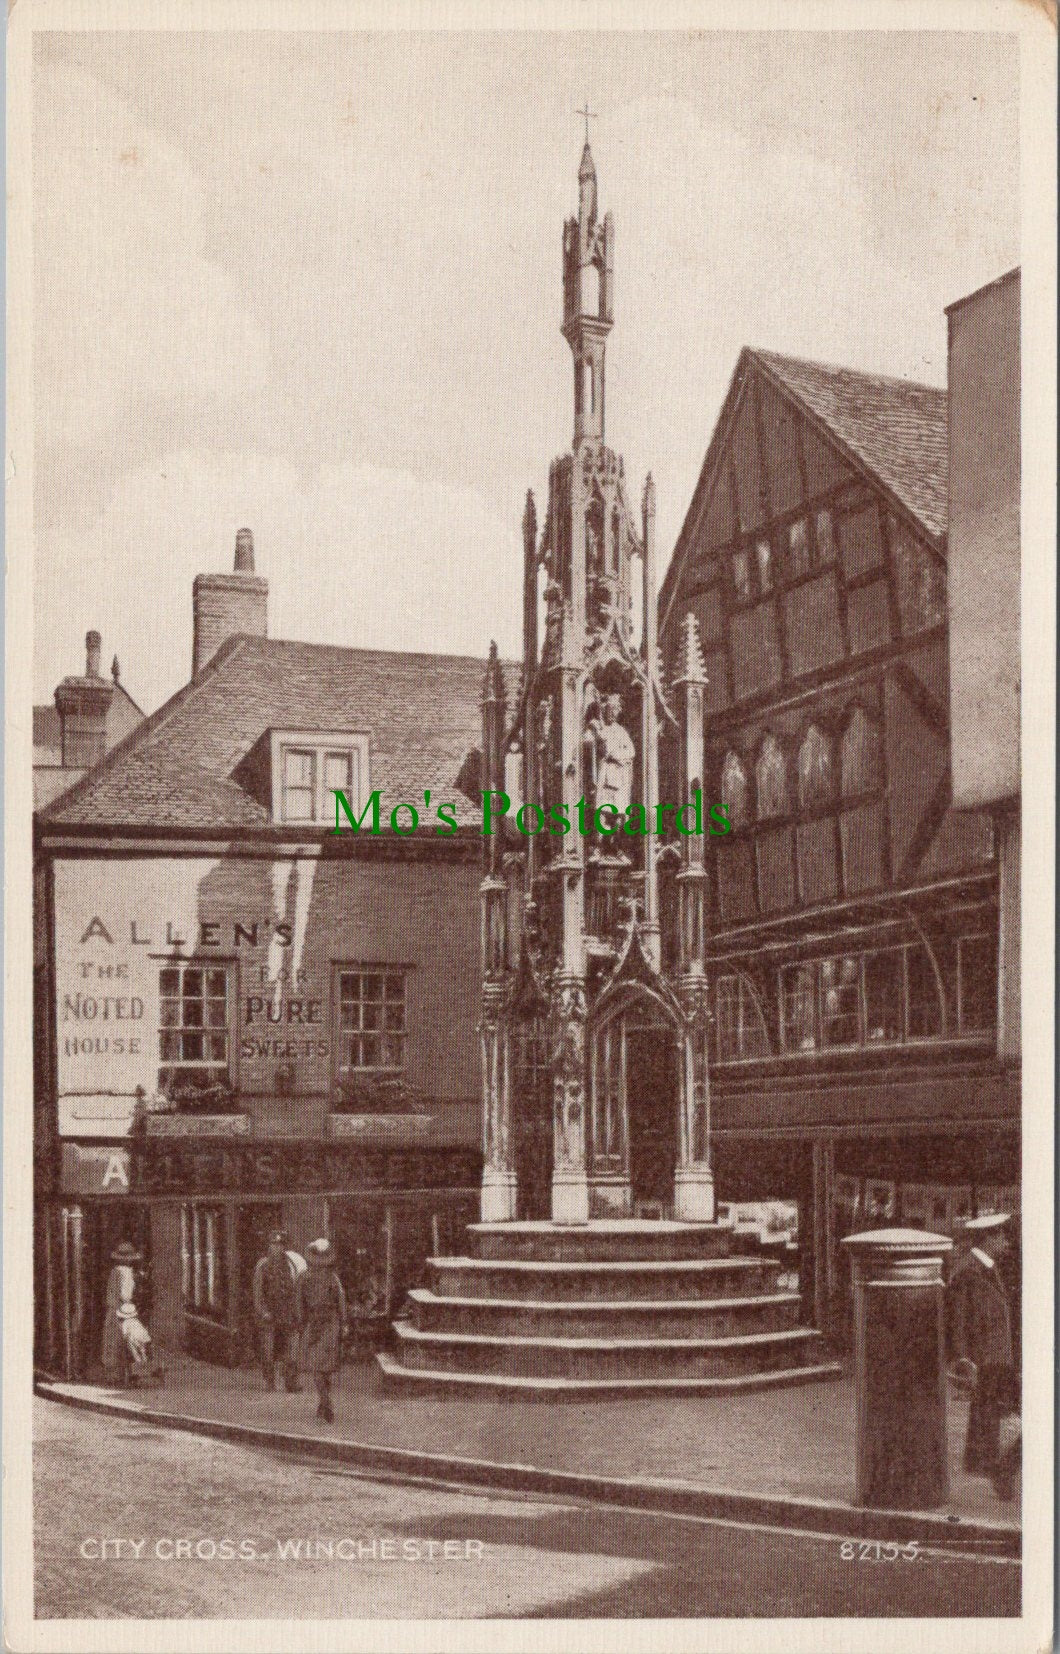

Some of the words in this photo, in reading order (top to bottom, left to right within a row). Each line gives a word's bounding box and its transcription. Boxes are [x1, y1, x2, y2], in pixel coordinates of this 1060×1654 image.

[80, 916, 293, 947] ALLEN'S
[80, 961, 129, 978] THE
[259, 966, 308, 983] FOR
[62, 993, 144, 1021] NOTED
[246, 997, 323, 1024] PURE
[64, 1037, 142, 1055] HOUSE
[242, 1038, 330, 1059] SWEETS
